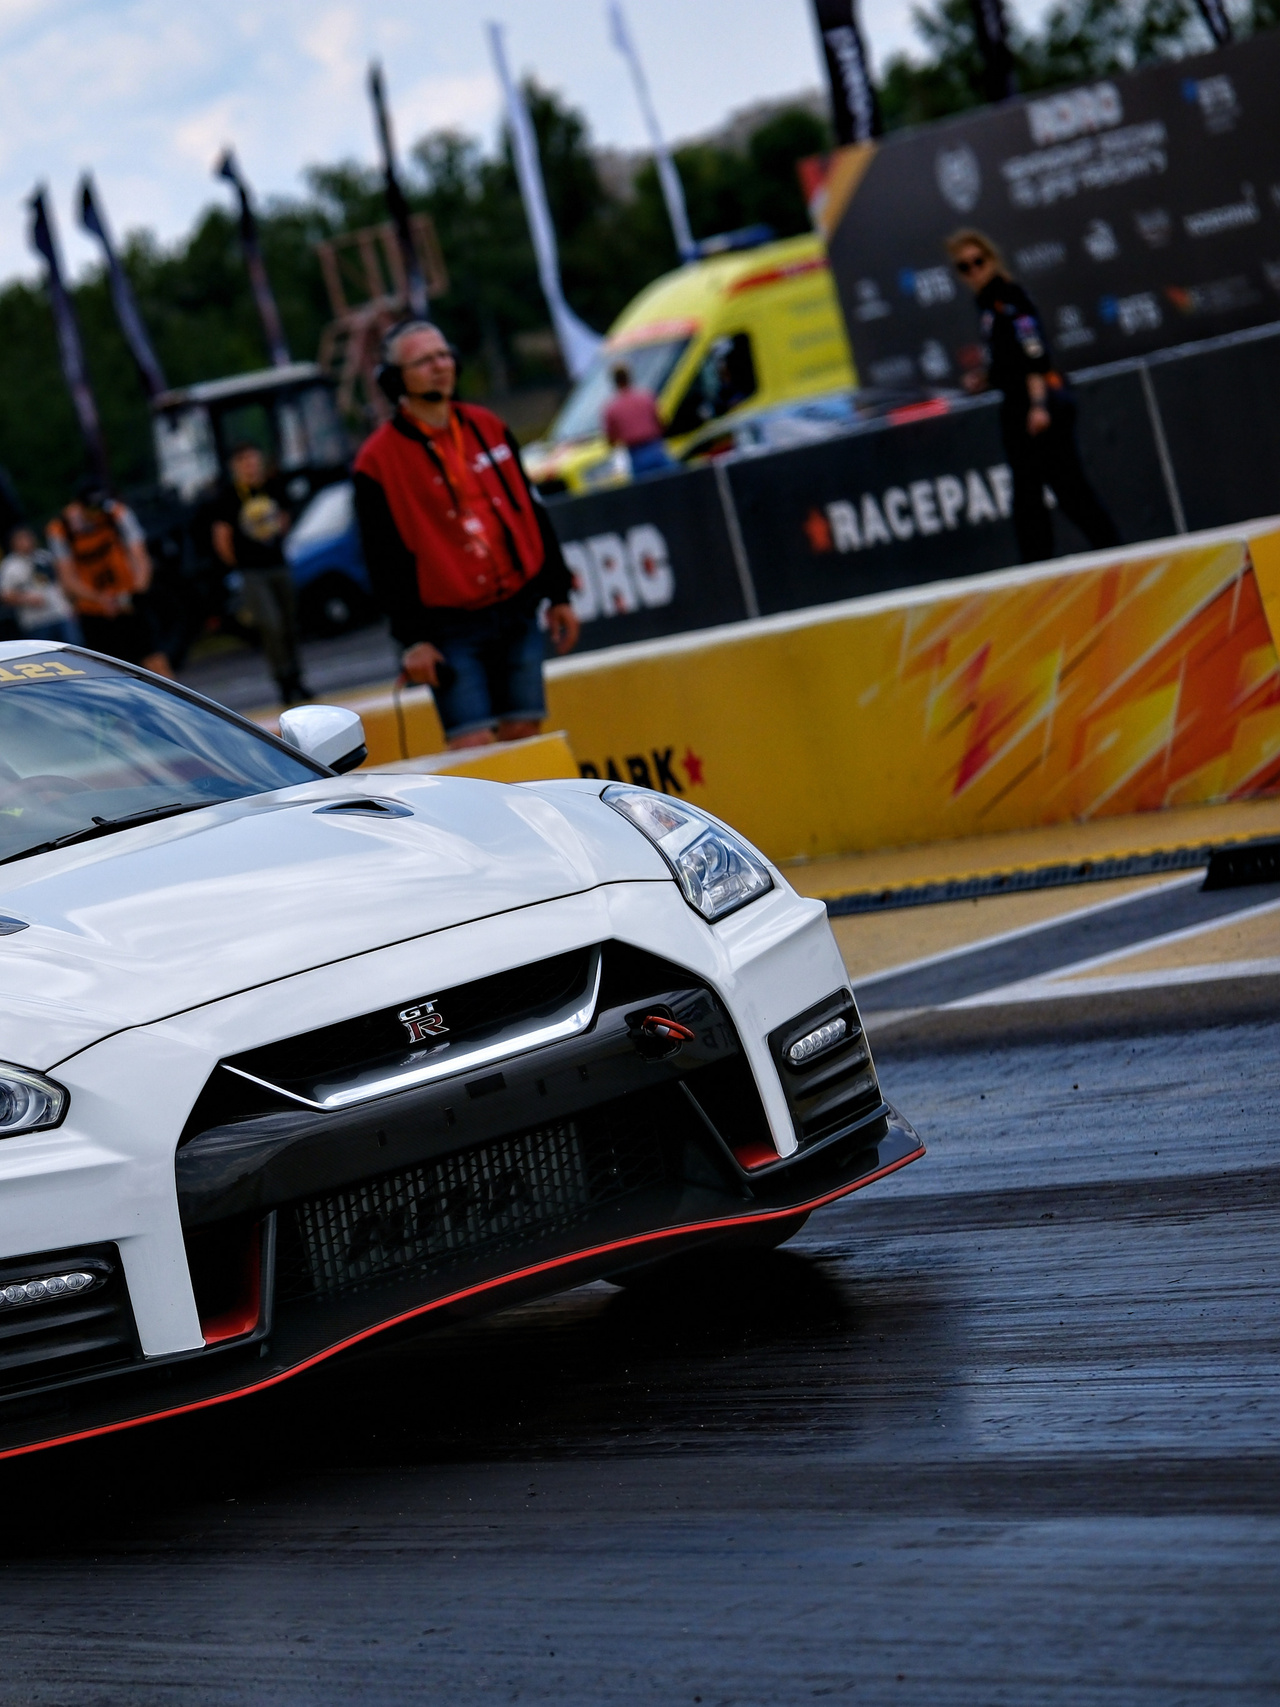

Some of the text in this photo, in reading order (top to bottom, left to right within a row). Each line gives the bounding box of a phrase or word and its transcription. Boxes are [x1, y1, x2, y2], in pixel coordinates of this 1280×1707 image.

[826, 463, 1057, 555] RACEPAR
[536, 522, 675, 630] DRC
[398, 999, 438, 1021] GT
[402, 1012, 450, 1043] R
